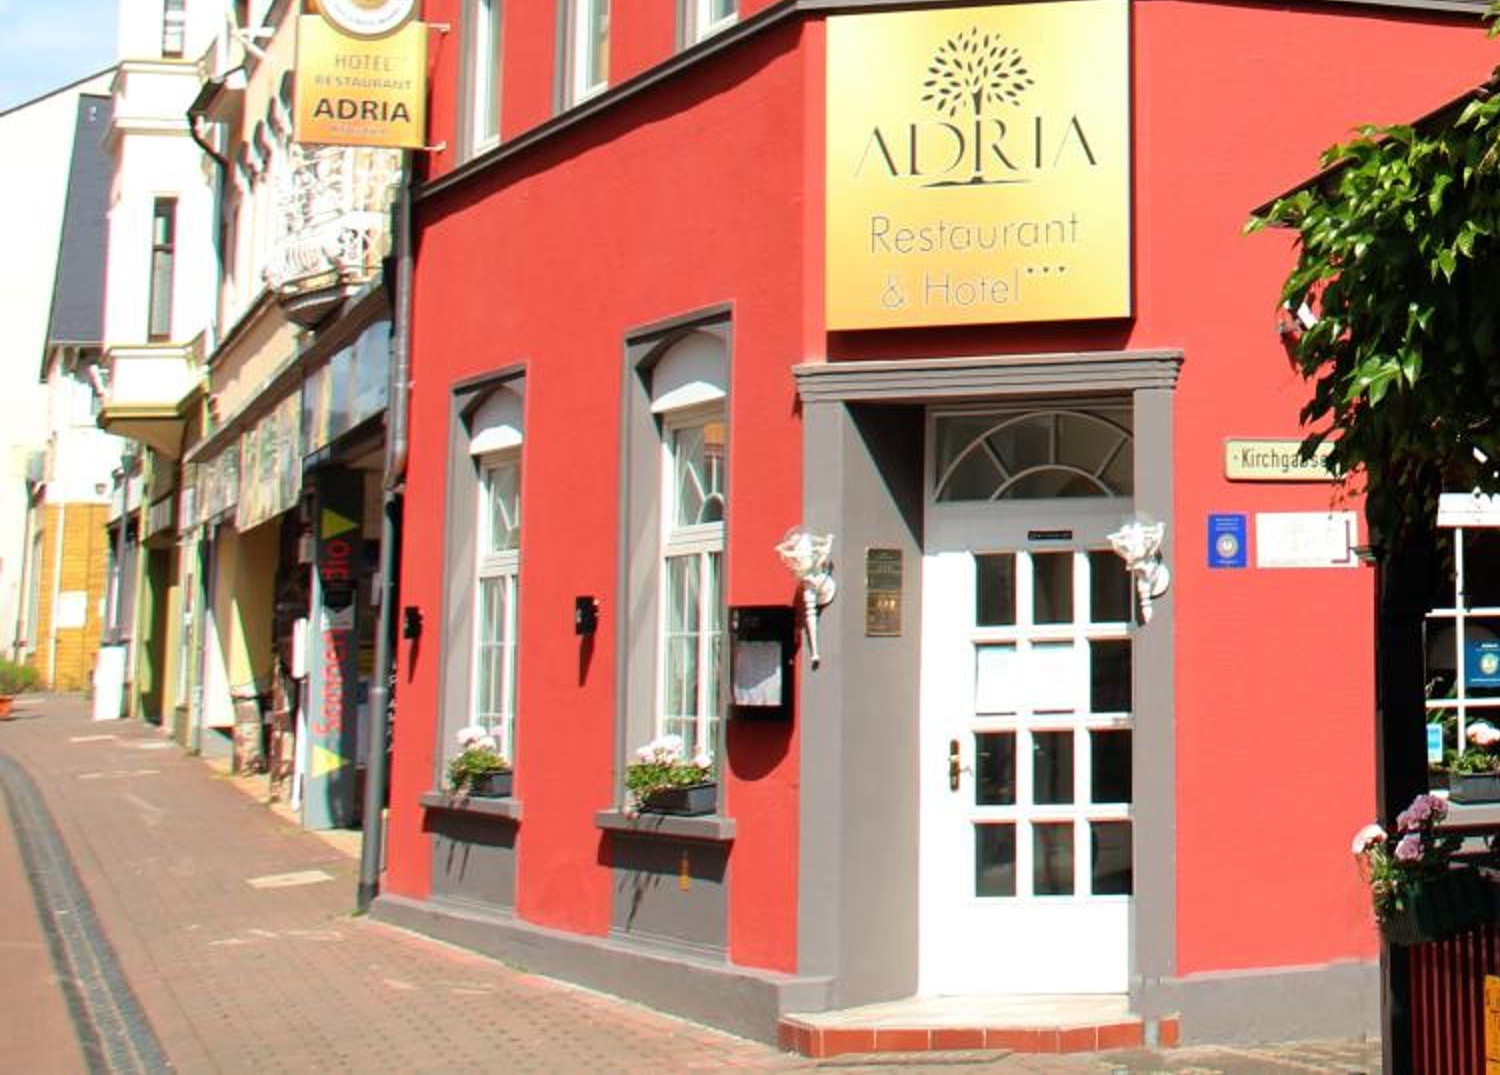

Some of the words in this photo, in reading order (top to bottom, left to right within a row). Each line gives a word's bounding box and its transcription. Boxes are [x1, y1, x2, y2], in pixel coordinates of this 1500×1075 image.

[314, 97, 411, 123] ADRIA
[855, 114, 1097, 177] ADRIA
[871, 211, 1079, 254] Restaurant
